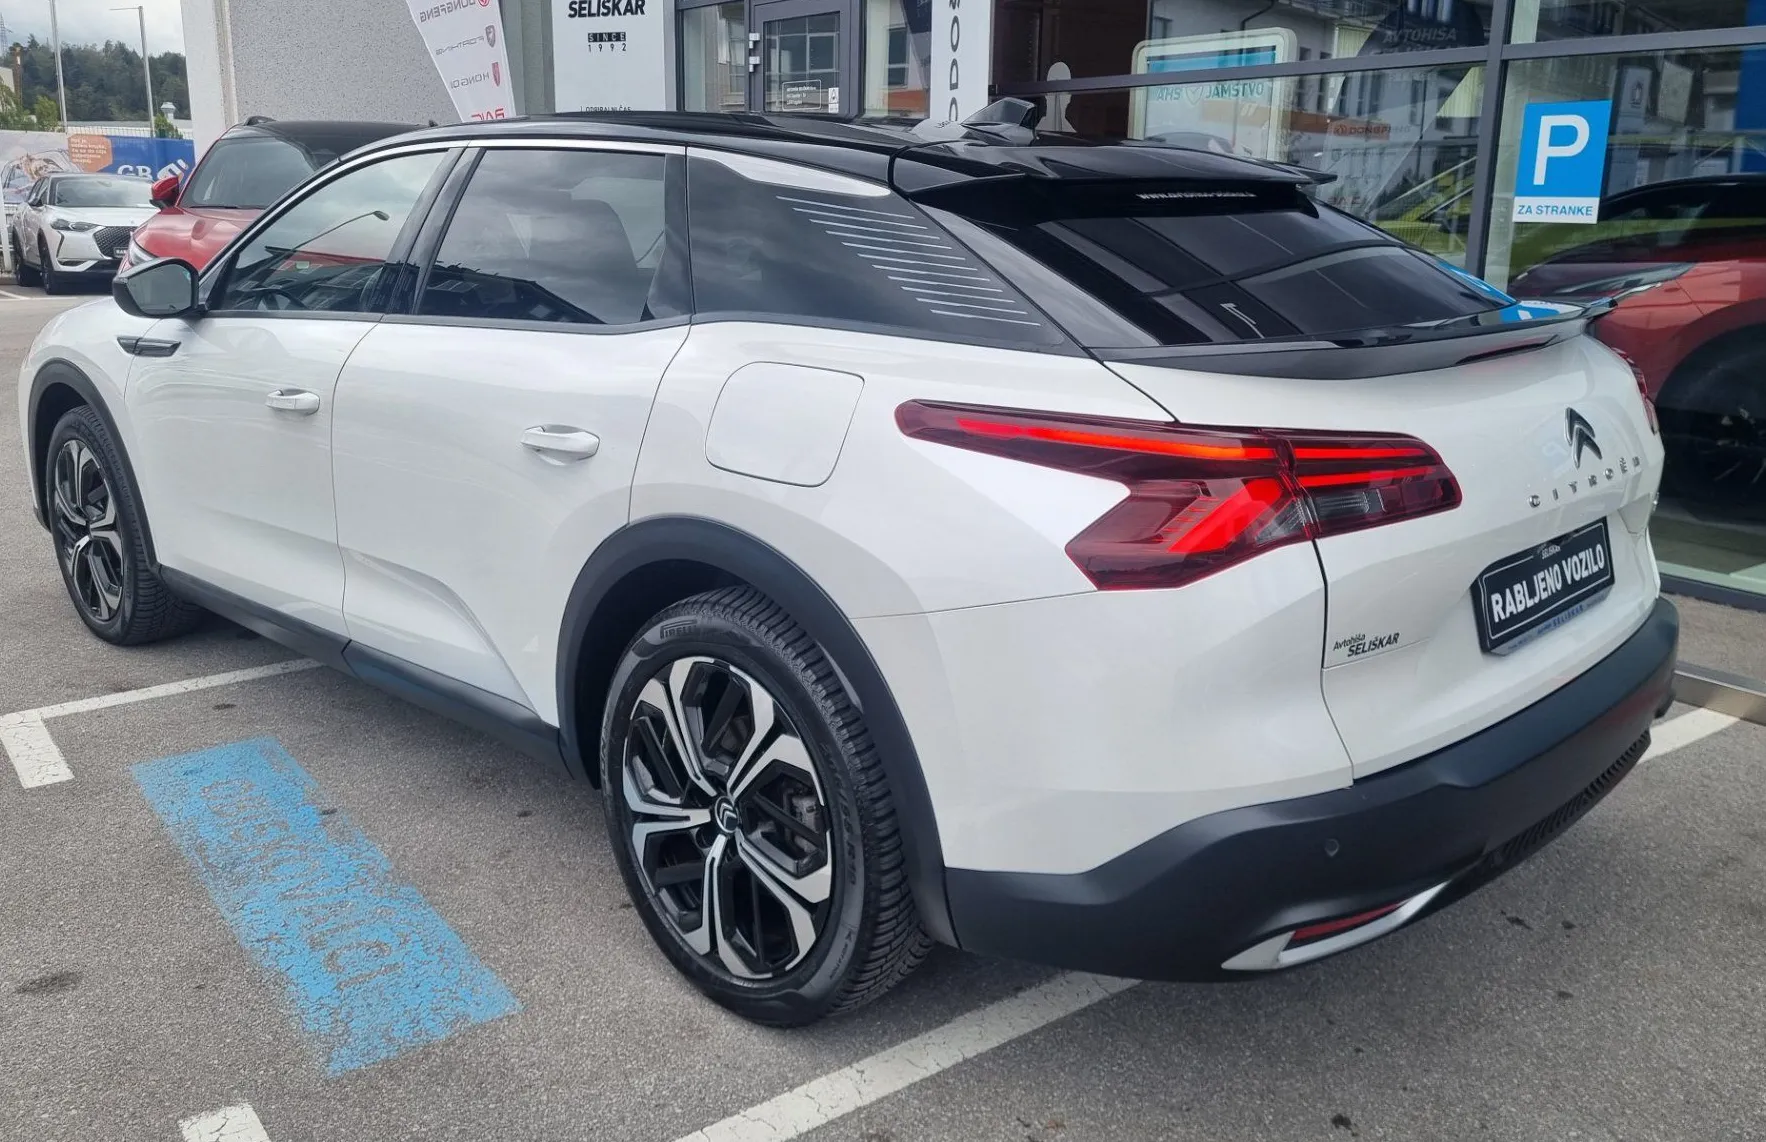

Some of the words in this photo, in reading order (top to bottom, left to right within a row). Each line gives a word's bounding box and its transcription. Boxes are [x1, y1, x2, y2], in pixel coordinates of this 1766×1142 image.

[588, 32, 626, 42] SINCE
[588, 42, 627, 52] 1992
[1156, 87, 1183, 101] AHS
[1205, 82, 1264, 99] JAMSTVO
[1533, 115, 1590, 185] P
[1517, 204, 1532, 215] ZA
[1537, 204, 1593, 216] STRANKE
[1490, 564, 1563, 623] RABLJENO
[1562, 543, 1605, 585] VOZILO
[1347, 631, 1400, 657] SELIŠKAR
